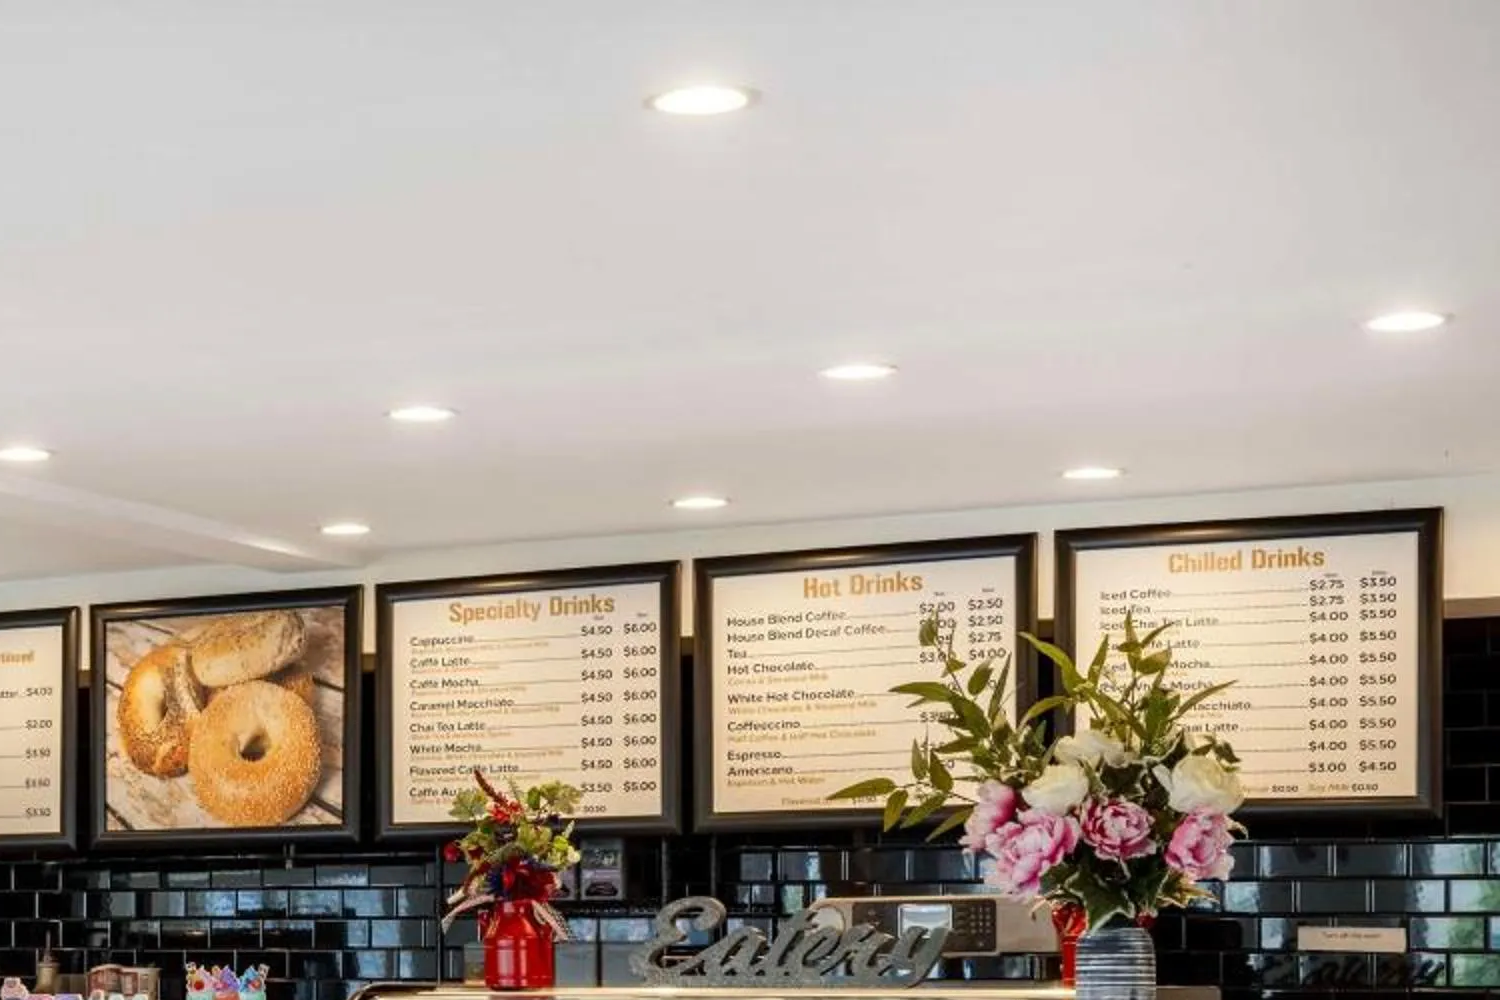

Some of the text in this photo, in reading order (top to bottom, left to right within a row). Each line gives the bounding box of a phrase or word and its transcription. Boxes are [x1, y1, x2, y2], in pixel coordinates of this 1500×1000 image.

[1168, 546, 1325, 575] Chilled Drinks
[803, 571, 923, 599] Hot Drinks
[1101, 589, 1127, 601] Iced
[1129, 588, 1171, 599] Coffee
[450, 594, 615, 625] Specialty Drinks
[1101, 605, 1127, 616] Iced
[1129, 603, 1151, 614] Tea
[727, 616, 765, 628] House
[767, 613, 803, 625] Blend
[805, 610, 847, 623] Coffee
[1185, 616, 1219, 627] Latte
[727, 632, 765, 644] House
[767, 629, 803, 642] Blend
[805, 626, 841, 640] Decaf
[844, 623, 885, 636] Coffee
[727, 648, 748, 660] Tea
[727, 664, 750, 676] Hot
[753, 660, 815, 674] Chocolate
[442, 677, 479, 688] Mocha
[728, 688, 855, 705] White Hot Chocolate
[410, 723, 431, 733] Chai
[434, 722, 455, 732] Tea
[457, 720, 485, 731] Latte
[1204, 722, 1238, 732] Latte
[410, 744, 443, 755] White
[444, 742, 482, 753] Mocha
[728, 750, 781, 762] Espresso
[728, 765, 793, 777] Americano
